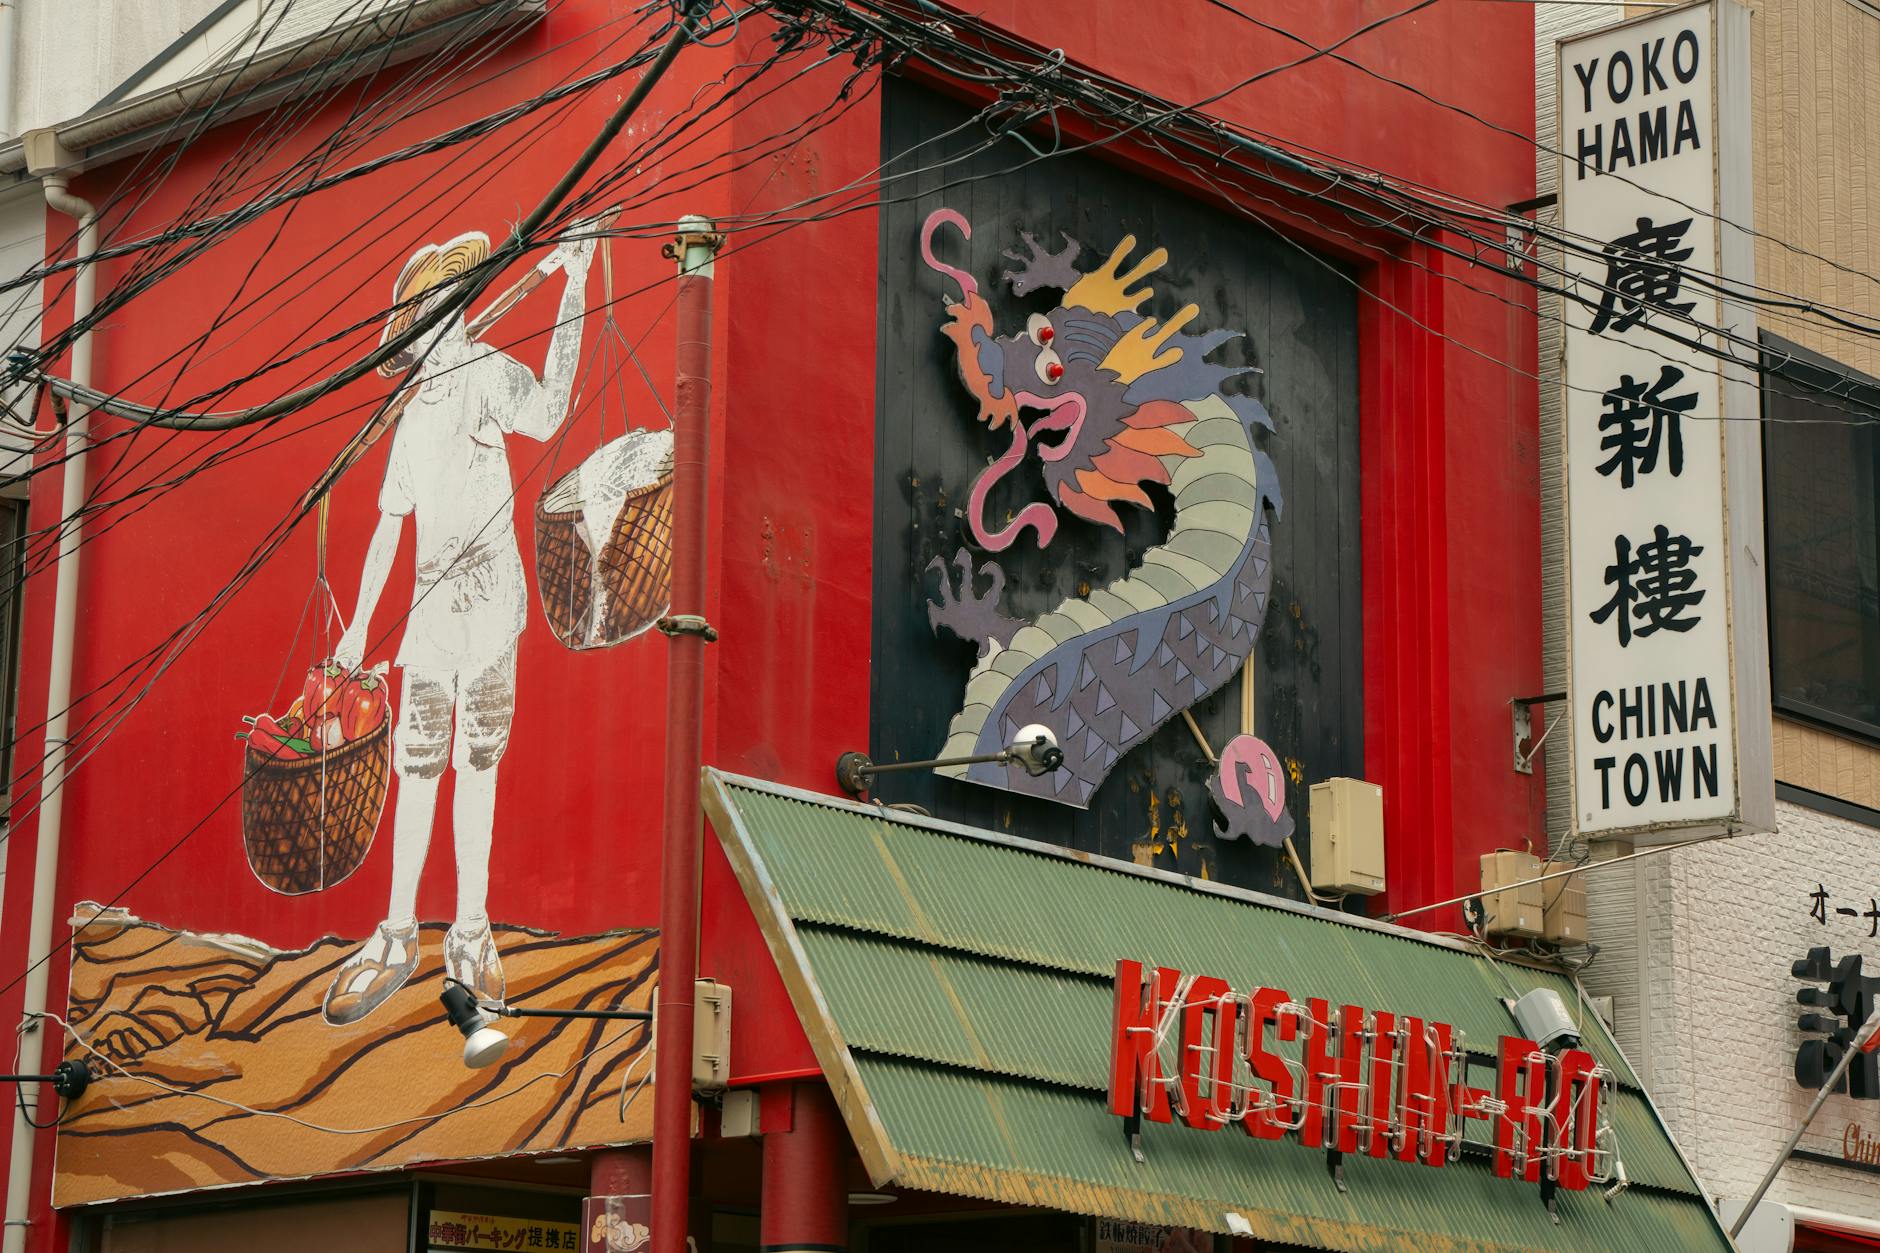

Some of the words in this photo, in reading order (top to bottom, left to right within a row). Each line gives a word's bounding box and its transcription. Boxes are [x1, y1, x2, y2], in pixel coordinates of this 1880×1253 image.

[1573, 29, 1699, 112] YOKO
[1577, 99, 1700, 180] HAMA
[1592, 677, 1717, 743] CHINA
[1594, 744, 1718, 809] TOWN
